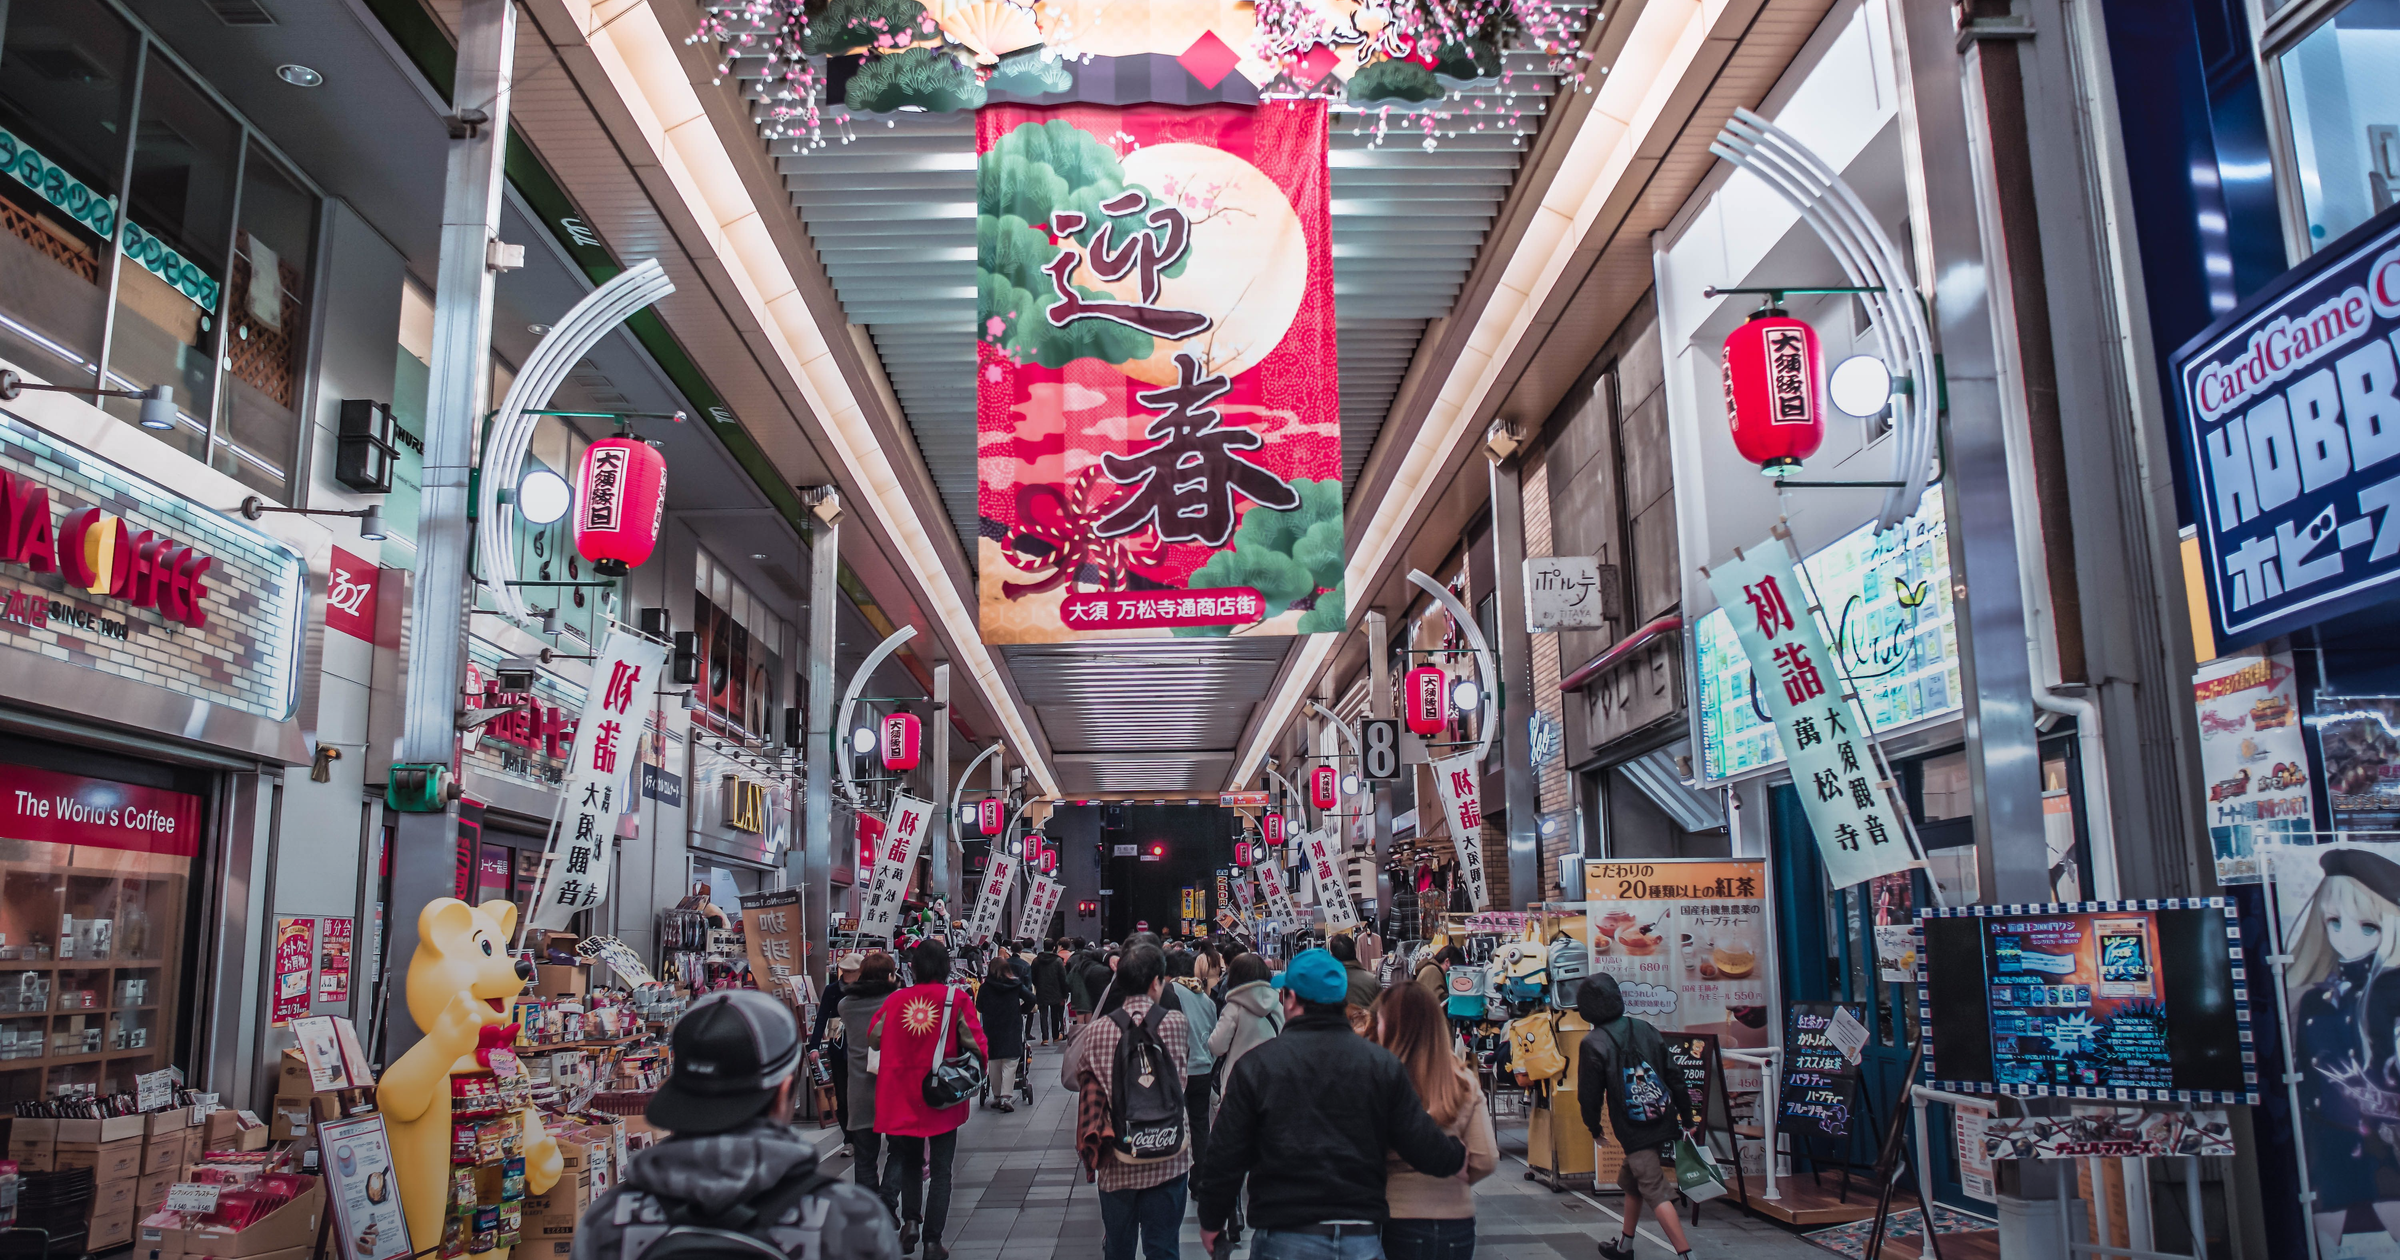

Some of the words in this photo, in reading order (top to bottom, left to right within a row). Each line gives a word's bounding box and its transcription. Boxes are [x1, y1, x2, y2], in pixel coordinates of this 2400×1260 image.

[2200, 295, 2366, 413] CardGame
[1040, 188, 1301, 547] 迎春
[2206, 338, 2400, 533] HOBB
[58, 507, 212, 629] COFFEE
[1535, 569, 1597, 607] ポルテ
[48, 600, 96, 632] SINCE
[98, 617, 130, 641] 1909
[1068, 600, 1109, 622] 大須
[1116, 596, 1257, 620] 万松寺通商店街
[1743, 574, 1826, 707] 初詣
[1367, 721, 1396, 777] 8
[1792, 717, 1860, 852] 萬松寺
[1824, 706, 1890, 846] 大須観音
[15, 790, 50, 818] The
[56, 796, 120, 827] World's
[124, 806, 176, 834] Coffee
[733, 774, 766, 834] LAX
[1311, 840, 1333, 881] 初詣
[1590, 864, 1654, 879] こだわりの
[1262, 867, 1280, 898] 初詣
[1618, 877, 1756, 900] 20種類以上の紅茶
[1321, 882, 1340, 923] 萬松寺
[1681, 904, 1761, 916] 国産有機無農薬の
[323, 919, 351, 936] 節分会
[1466, 916, 1521, 927] SALE
[1695, 916, 1749, 928] ハーブティー
[283, 940, 307, 956] おトクに
[1639, 963, 1669, 972] 680円
[287, 1003, 300, 1015] 1/31
[1698, 993, 1731, 1001] カモミール
[1734, 992, 1763, 1001] 550円
[1796, 1057, 1842, 1070] オススメ紅茶
[1630, 1082, 1657, 1095] GREAT
[1632, 1088, 1663, 1104] OCEAN
[1144, 1127, 1160, 1135] Enjoy
